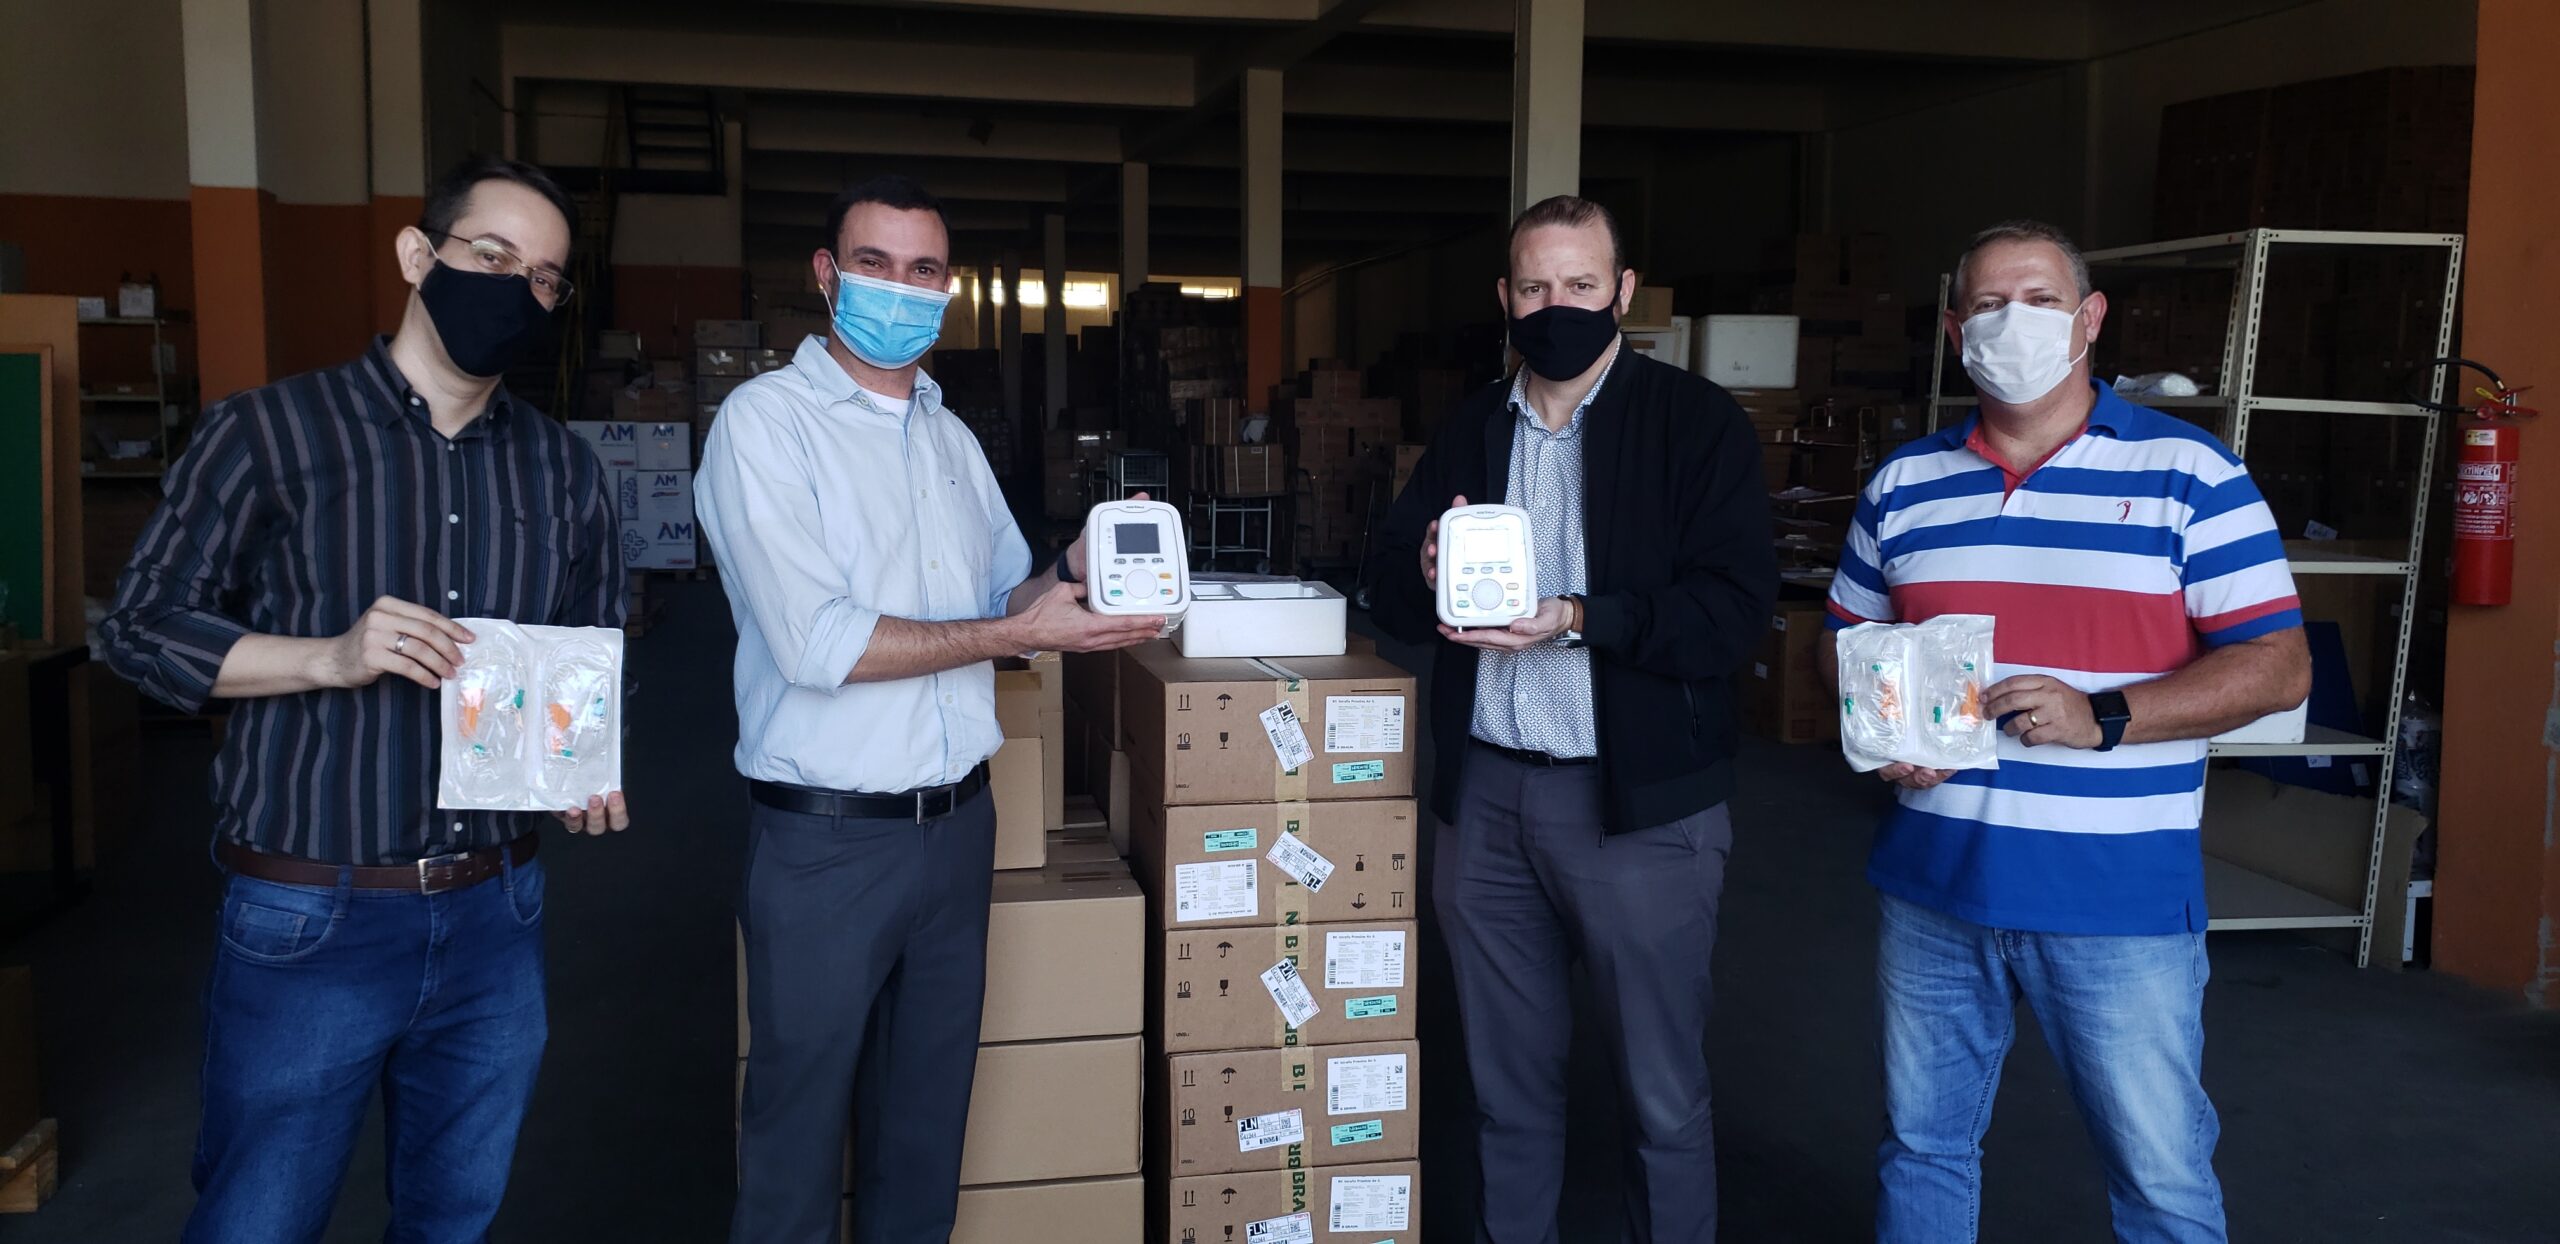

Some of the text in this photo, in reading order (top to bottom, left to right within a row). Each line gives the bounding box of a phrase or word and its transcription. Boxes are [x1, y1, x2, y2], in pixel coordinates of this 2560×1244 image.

[600, 424, 634, 441] AM
[652, 425, 674, 437] AM
[654, 474, 677, 486] AM
[657, 522, 692, 540] AM
[1178, 732, 1191, 744] 10
[1178, 981, 1191, 992] 10
[1183, 1108, 1195, 1120] 10
[1239, 1117, 1258, 1133] FLN
[1182, 1228, 1195, 1239] 10
[1248, 1222, 1268, 1237] FLN
